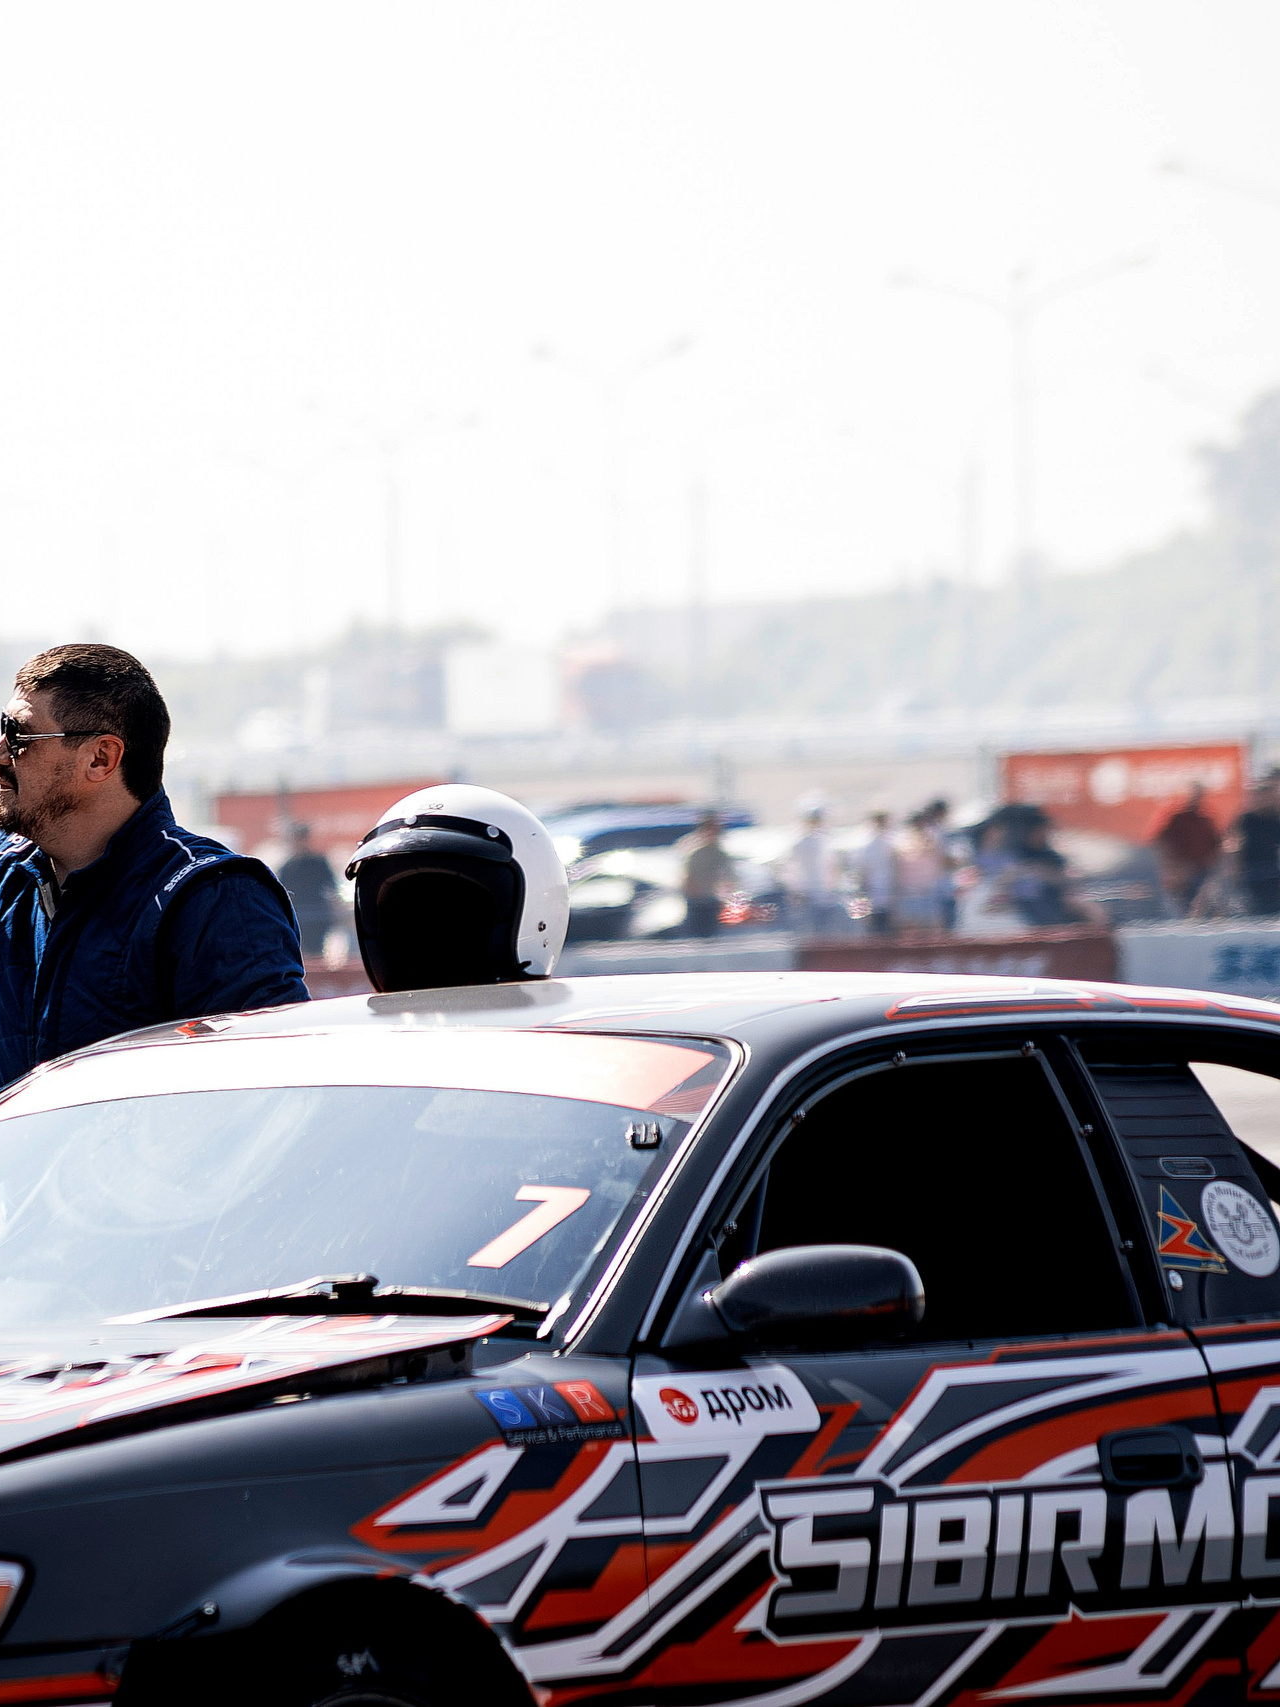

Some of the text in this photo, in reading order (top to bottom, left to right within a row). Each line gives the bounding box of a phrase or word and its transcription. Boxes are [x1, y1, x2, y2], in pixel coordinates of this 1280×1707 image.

[466, 1184, 592, 1270] 7
[488, 1383, 606, 1425] SKR
[767, 1486, 1108, 1619] SIBIR
